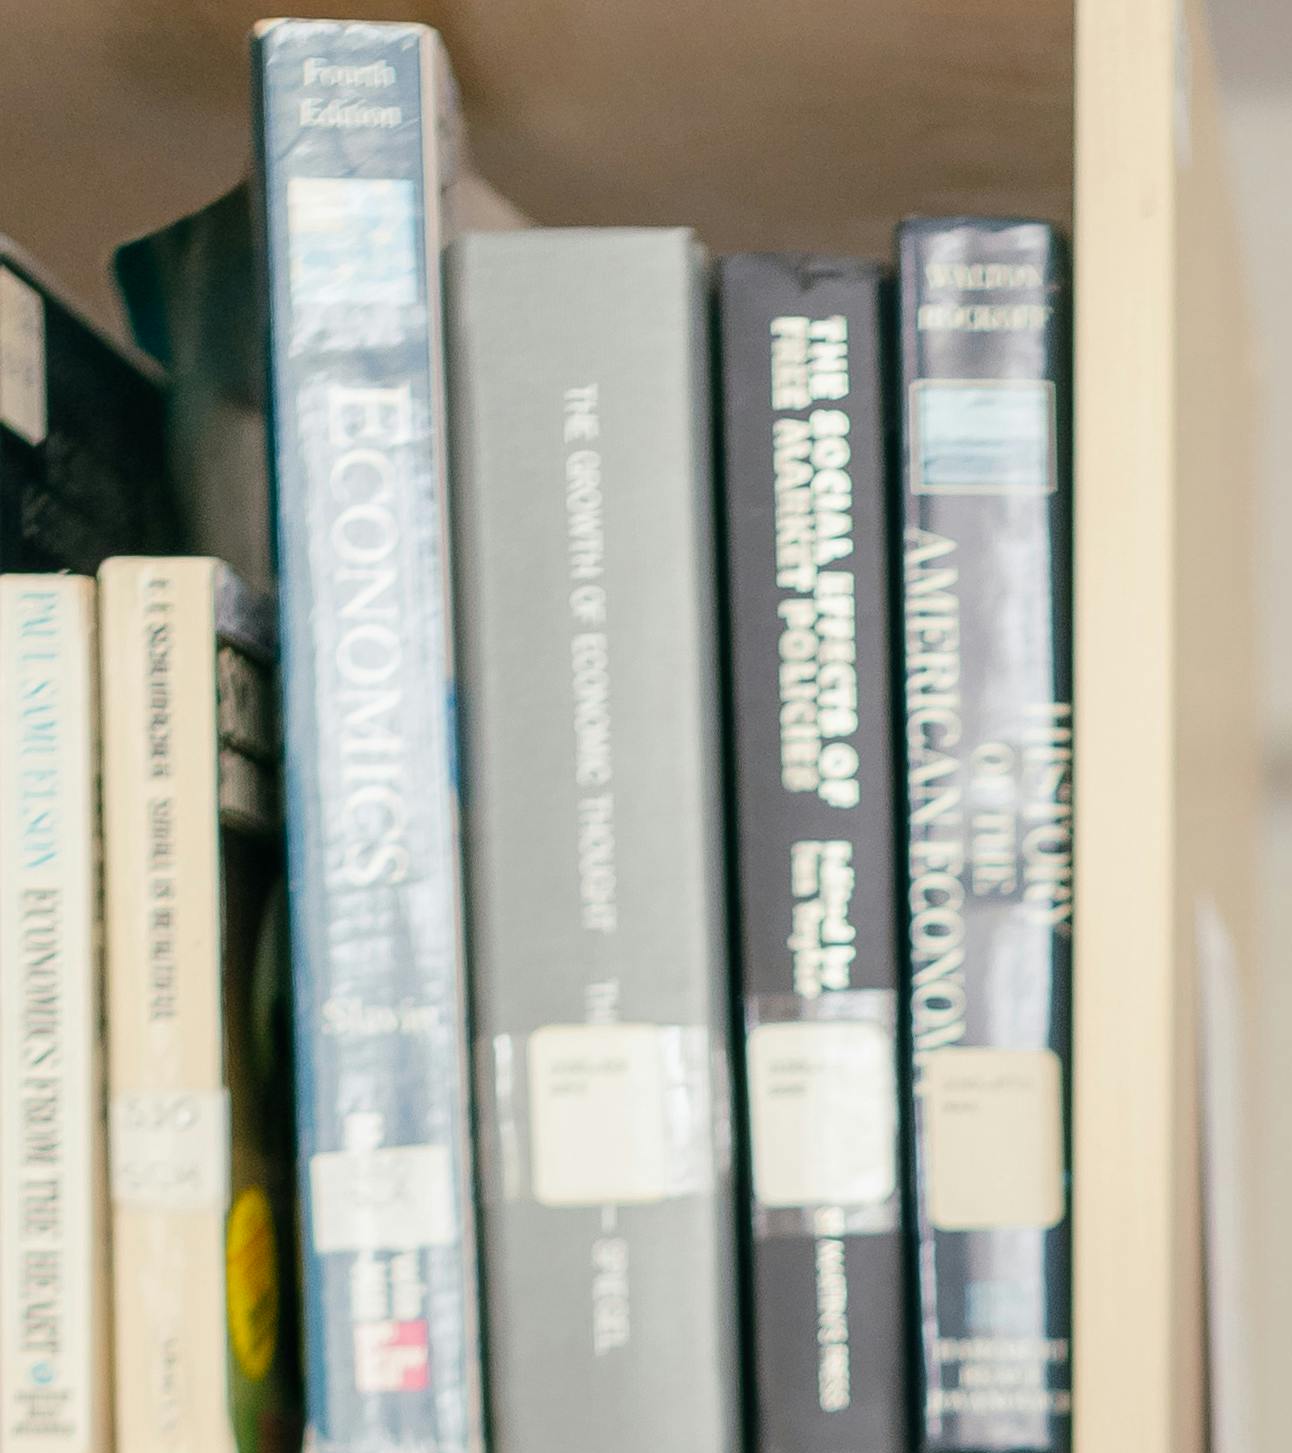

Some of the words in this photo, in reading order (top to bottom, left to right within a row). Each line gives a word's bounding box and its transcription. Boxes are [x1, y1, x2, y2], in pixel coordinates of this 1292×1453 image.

[299, 98, 402, 129] Edition
[303, 57, 396, 88] Fourth
[564, 383, 600, 450] THE
[770, 315, 811, 411] FREE
[808, 316, 850, 400] THE
[566, 451, 606, 579] GROWTH
[772, 420, 817, 590] MARKET
[812, 411, 854, 565] SOCIAL
[15, 592, 75, 662] PAUL
[325, 386, 412, 886] ECONOMICS
[570, 585, 608, 625] OF
[817, 573, 860, 736] EFFECTS
[570, 633, 610, 784] ECONOMIC
[775, 602, 820, 793] POLICIES
[908, 527, 964, 840] AMERICAN
[14, 680, 77, 870] SAMUELSON
[819, 745, 861, 807] OF
[1020, 700, 1072, 936] HISTORY
[577, 795, 619, 934] THOUGHT
[971, 812, 1019, 897] THE
[17, 889, 66, 1067] ECONOMICS
[909, 840, 968, 1098] ECONOM
[17, 1078, 65, 1163] FROM
[18, 1179, 66, 1236] THE
[18, 1251, 66, 1356] HEART
